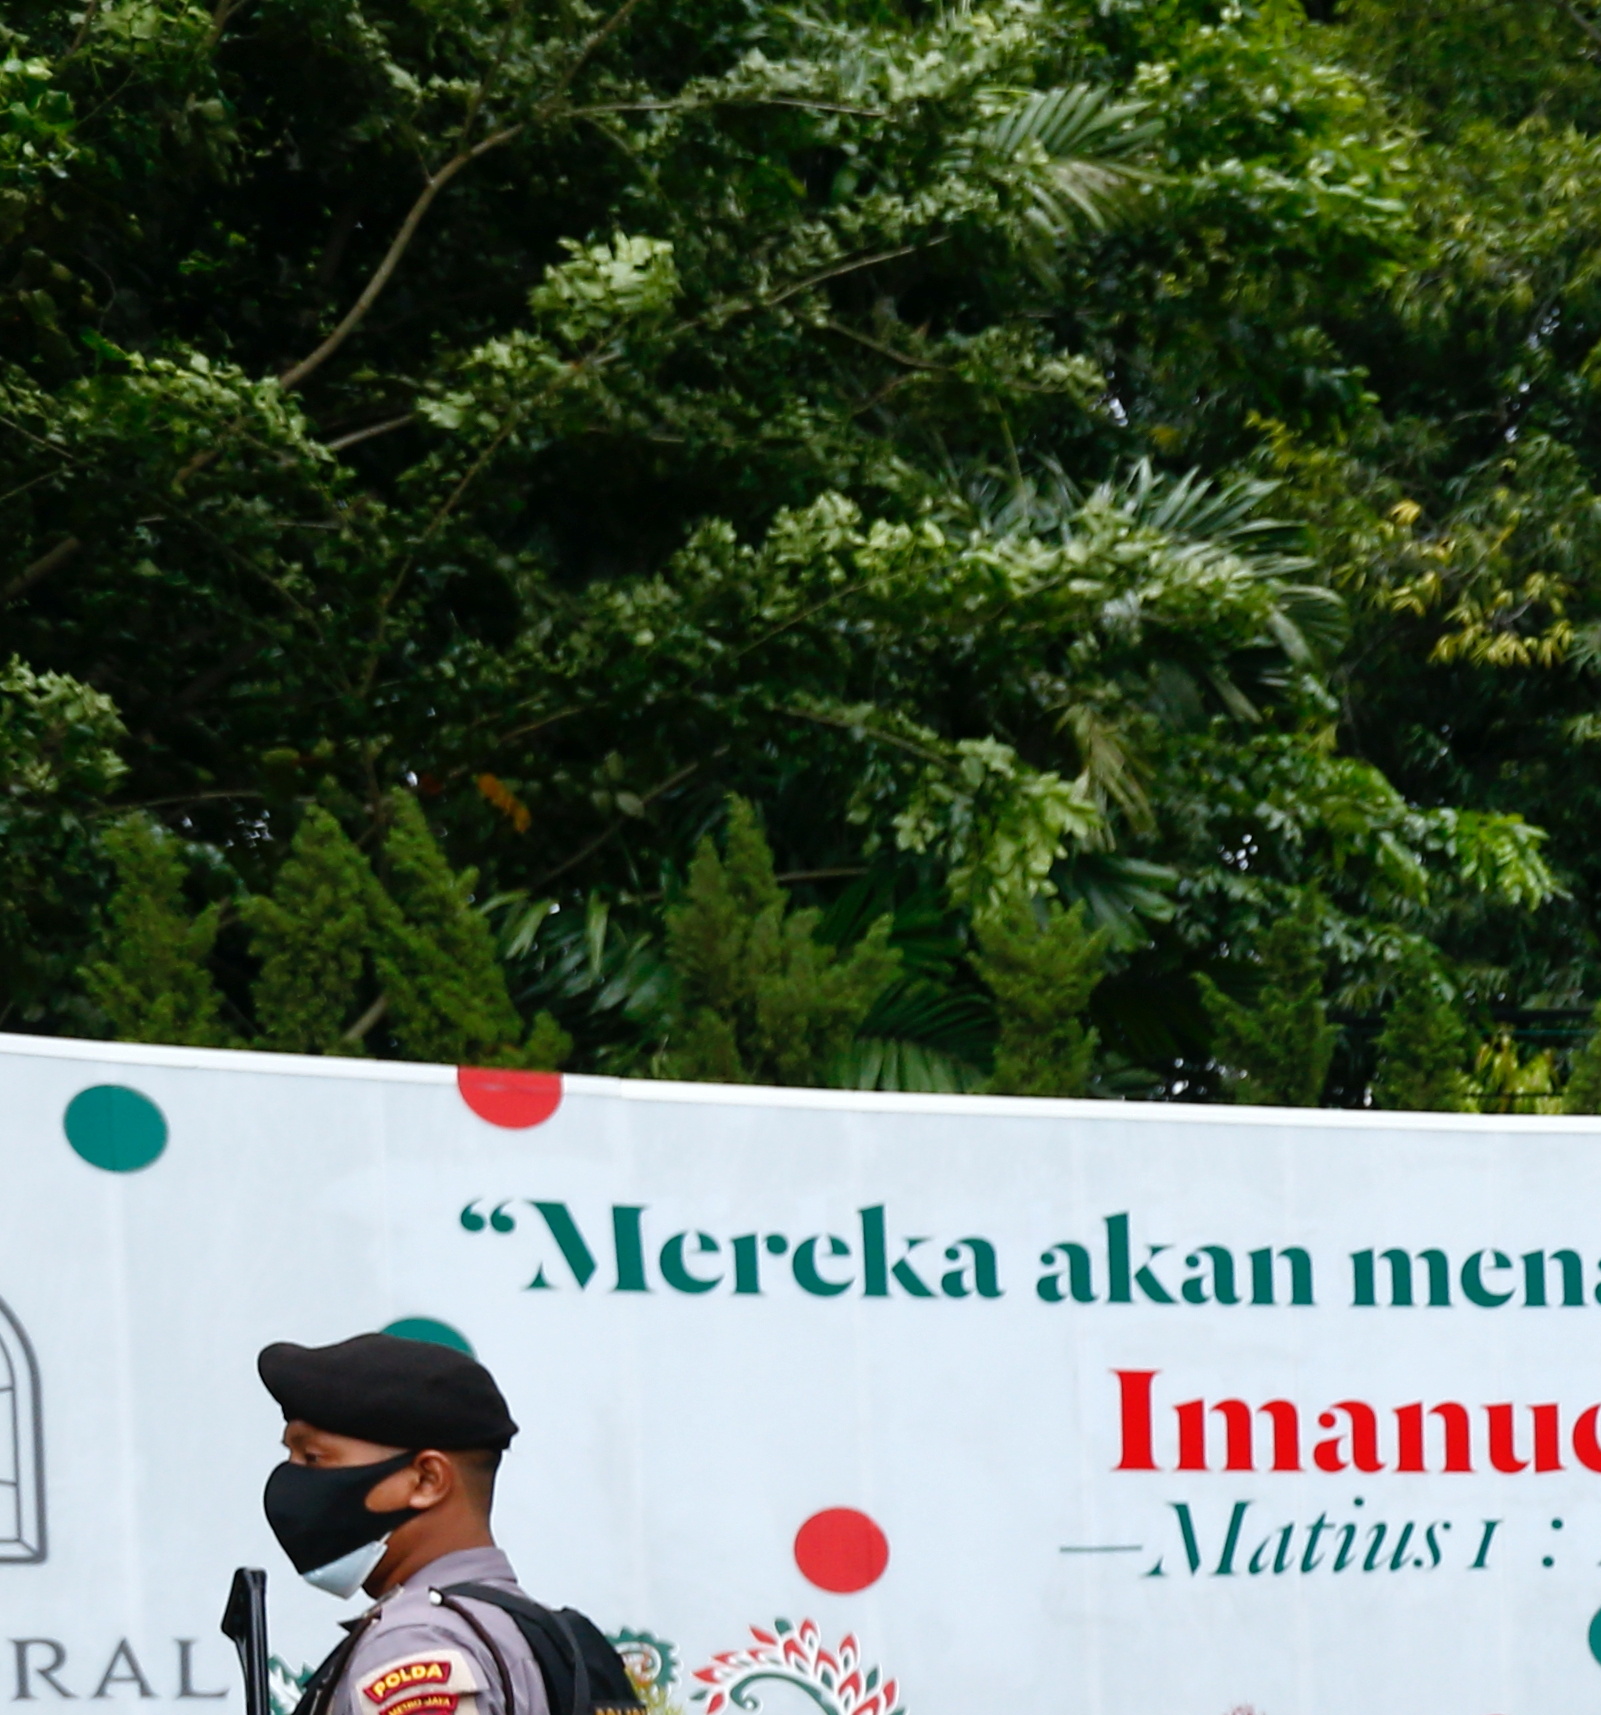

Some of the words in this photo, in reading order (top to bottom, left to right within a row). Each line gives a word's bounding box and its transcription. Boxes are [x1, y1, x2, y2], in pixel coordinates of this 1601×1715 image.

[459, 1200, 1003, 1299] “Mereka
[1036, 1212, 1313, 1306] akan
[1541, 1517, 1564, 1569] :
[8, 1635, 231, 1700] RAL
[373, 1662, 443, 1699] POLDA
